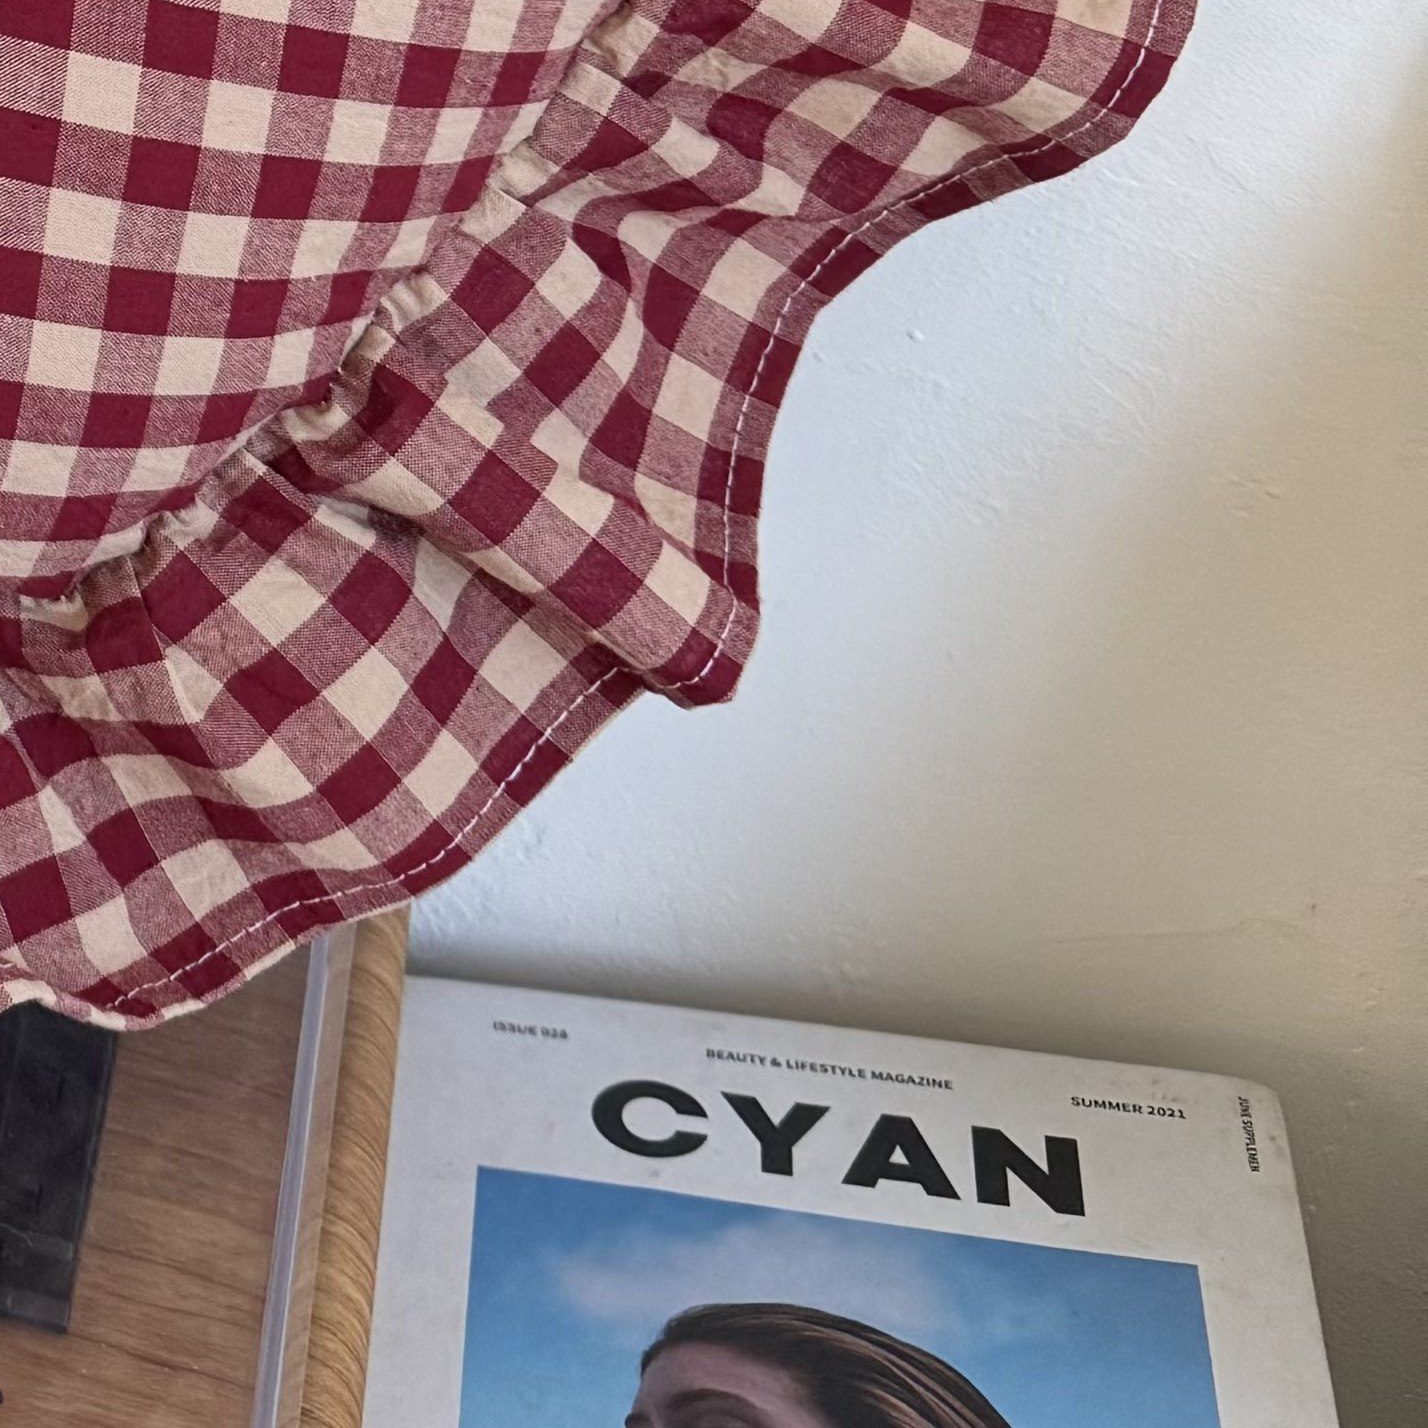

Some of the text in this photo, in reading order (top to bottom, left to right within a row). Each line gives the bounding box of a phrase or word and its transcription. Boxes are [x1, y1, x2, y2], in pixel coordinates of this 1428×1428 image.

[705, 1047, 954, 1091] BEAUTY & LIFESTYLE MAGAZINE
[1070, 1095, 1187, 1120] SUMMER 2021
[591, 1079, 1086, 1217] CYAN
